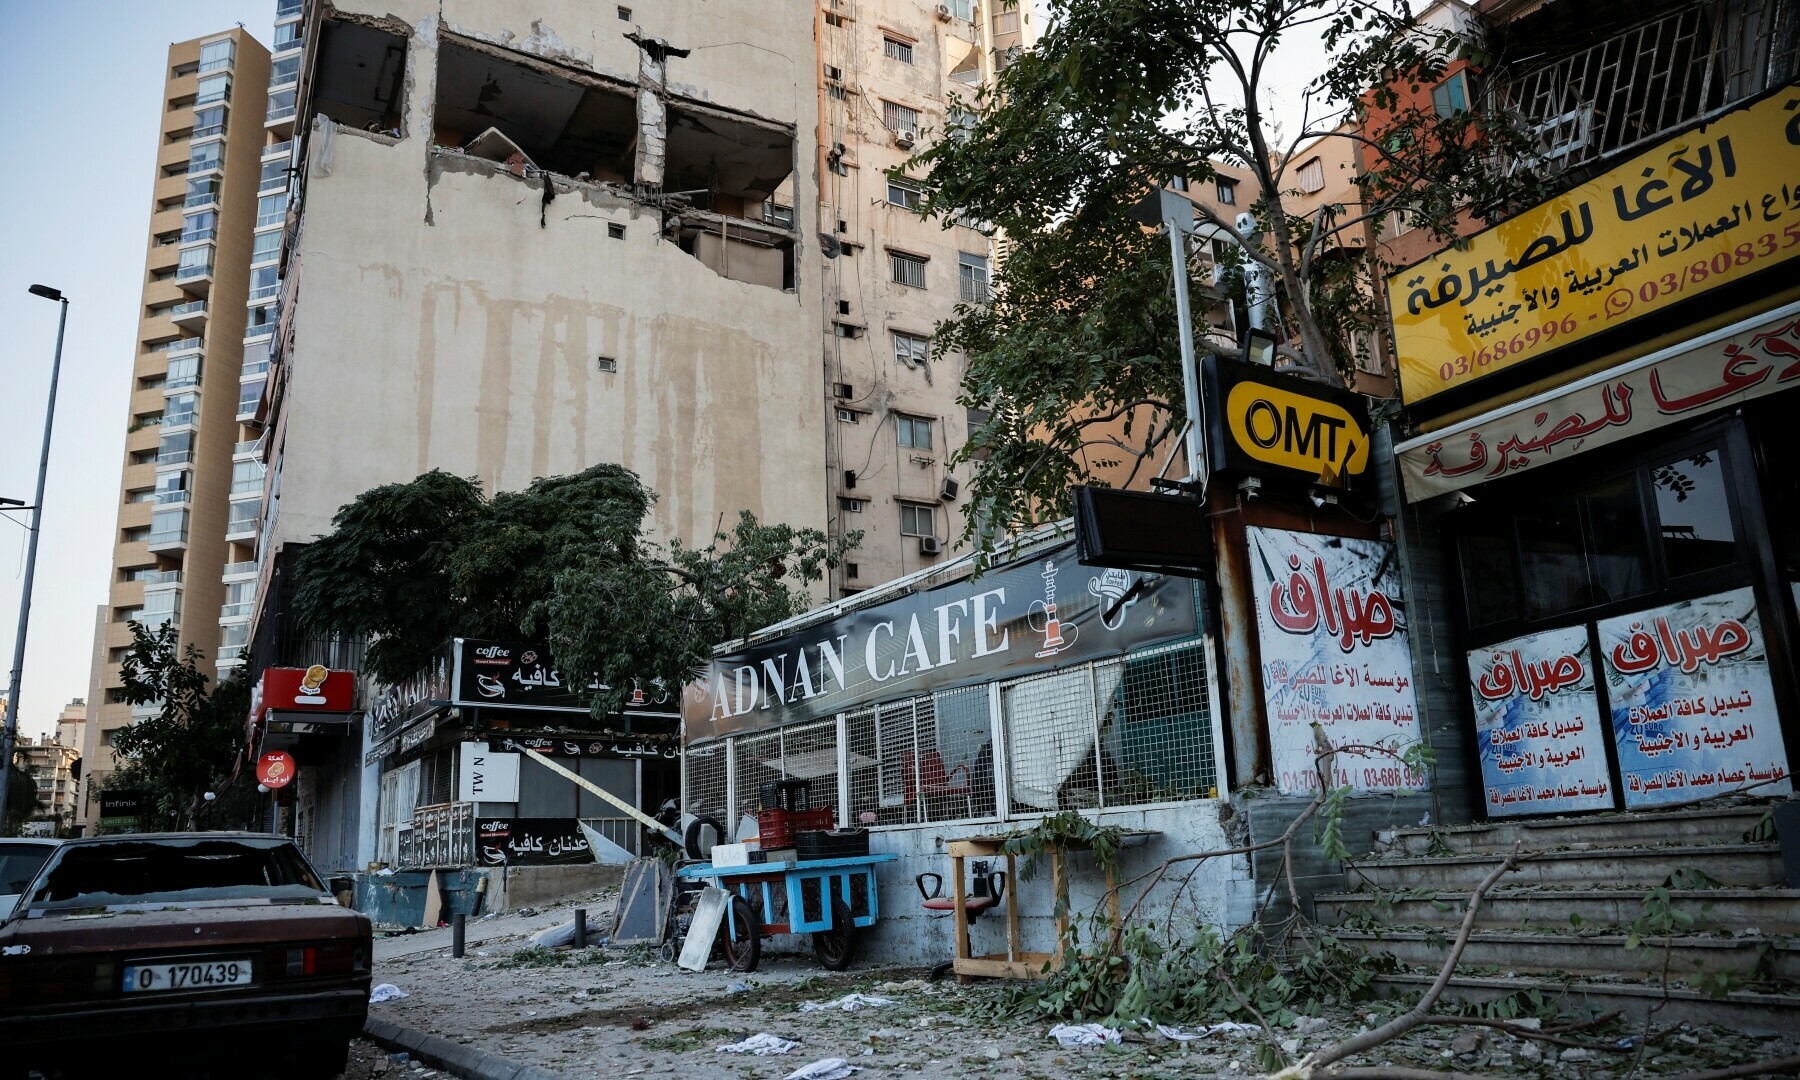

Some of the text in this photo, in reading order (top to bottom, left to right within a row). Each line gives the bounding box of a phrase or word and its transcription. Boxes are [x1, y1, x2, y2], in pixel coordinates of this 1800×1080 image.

[1406, 134, 1737, 316] الآغا للصيرفة
[1657, 200, 1752, 258] العملات
[1563, 243, 1649, 296] العربية
[1439, 312, 1578, 381] 03/686996
[1640, 220, 1800, 303] 03/80835
[1463, 286, 1561, 338] والأجنبية
[1244, 398, 1346, 463] OMT
[1423, 382, 1634, 479] للصيرفة
[1269, 553, 1395, 652] صراف
[475, 646, 510, 658] coffee
[709, 588, 1010, 722] ADNAN CAFE
[1611, 615, 1751, 674] صراف
[511, 663, 560, 691] كافيه
[1272, 659, 1327, 691] للصيرفة
[1329, 662, 1360, 687] الآغا
[1363, 663, 1409, 694] مؤسسة
[1479, 649, 1584, 701] صراف
[1316, 700, 1345, 726] العربية
[1346, 702, 1373, 722] العملات
[1373, 702, 1391, 720] كافة
[1393, 704, 1413, 727] تبديل
[1629, 689, 1752, 725] تبديل كافة العملات
[524, 738, 553, 747] coffee
[1491, 716, 1584, 745] تبديل كافة العملات
[1636, 730, 1690, 757] الأجنبية
[1700, 723, 1754, 749] العربية
[610, 741, 659, 758] كافيه
[1496, 751, 1537, 774] الأجنبية
[1544, 746, 1585, 768] العربية
[1363, 767, 1401, 788] 03-686
[1626, 762, 1784, 795] مؤسسة عصام محمد الآغا للصرافة
[105, 799, 137, 808] Infinix
[1488, 779, 1607, 807] مؤسسة عصام محمد الآغا للصرافة
[480, 820, 509, 832] coffee
[508, 832, 589, 857] عدنان كافيه
[168, 963, 239, 988] 170439
